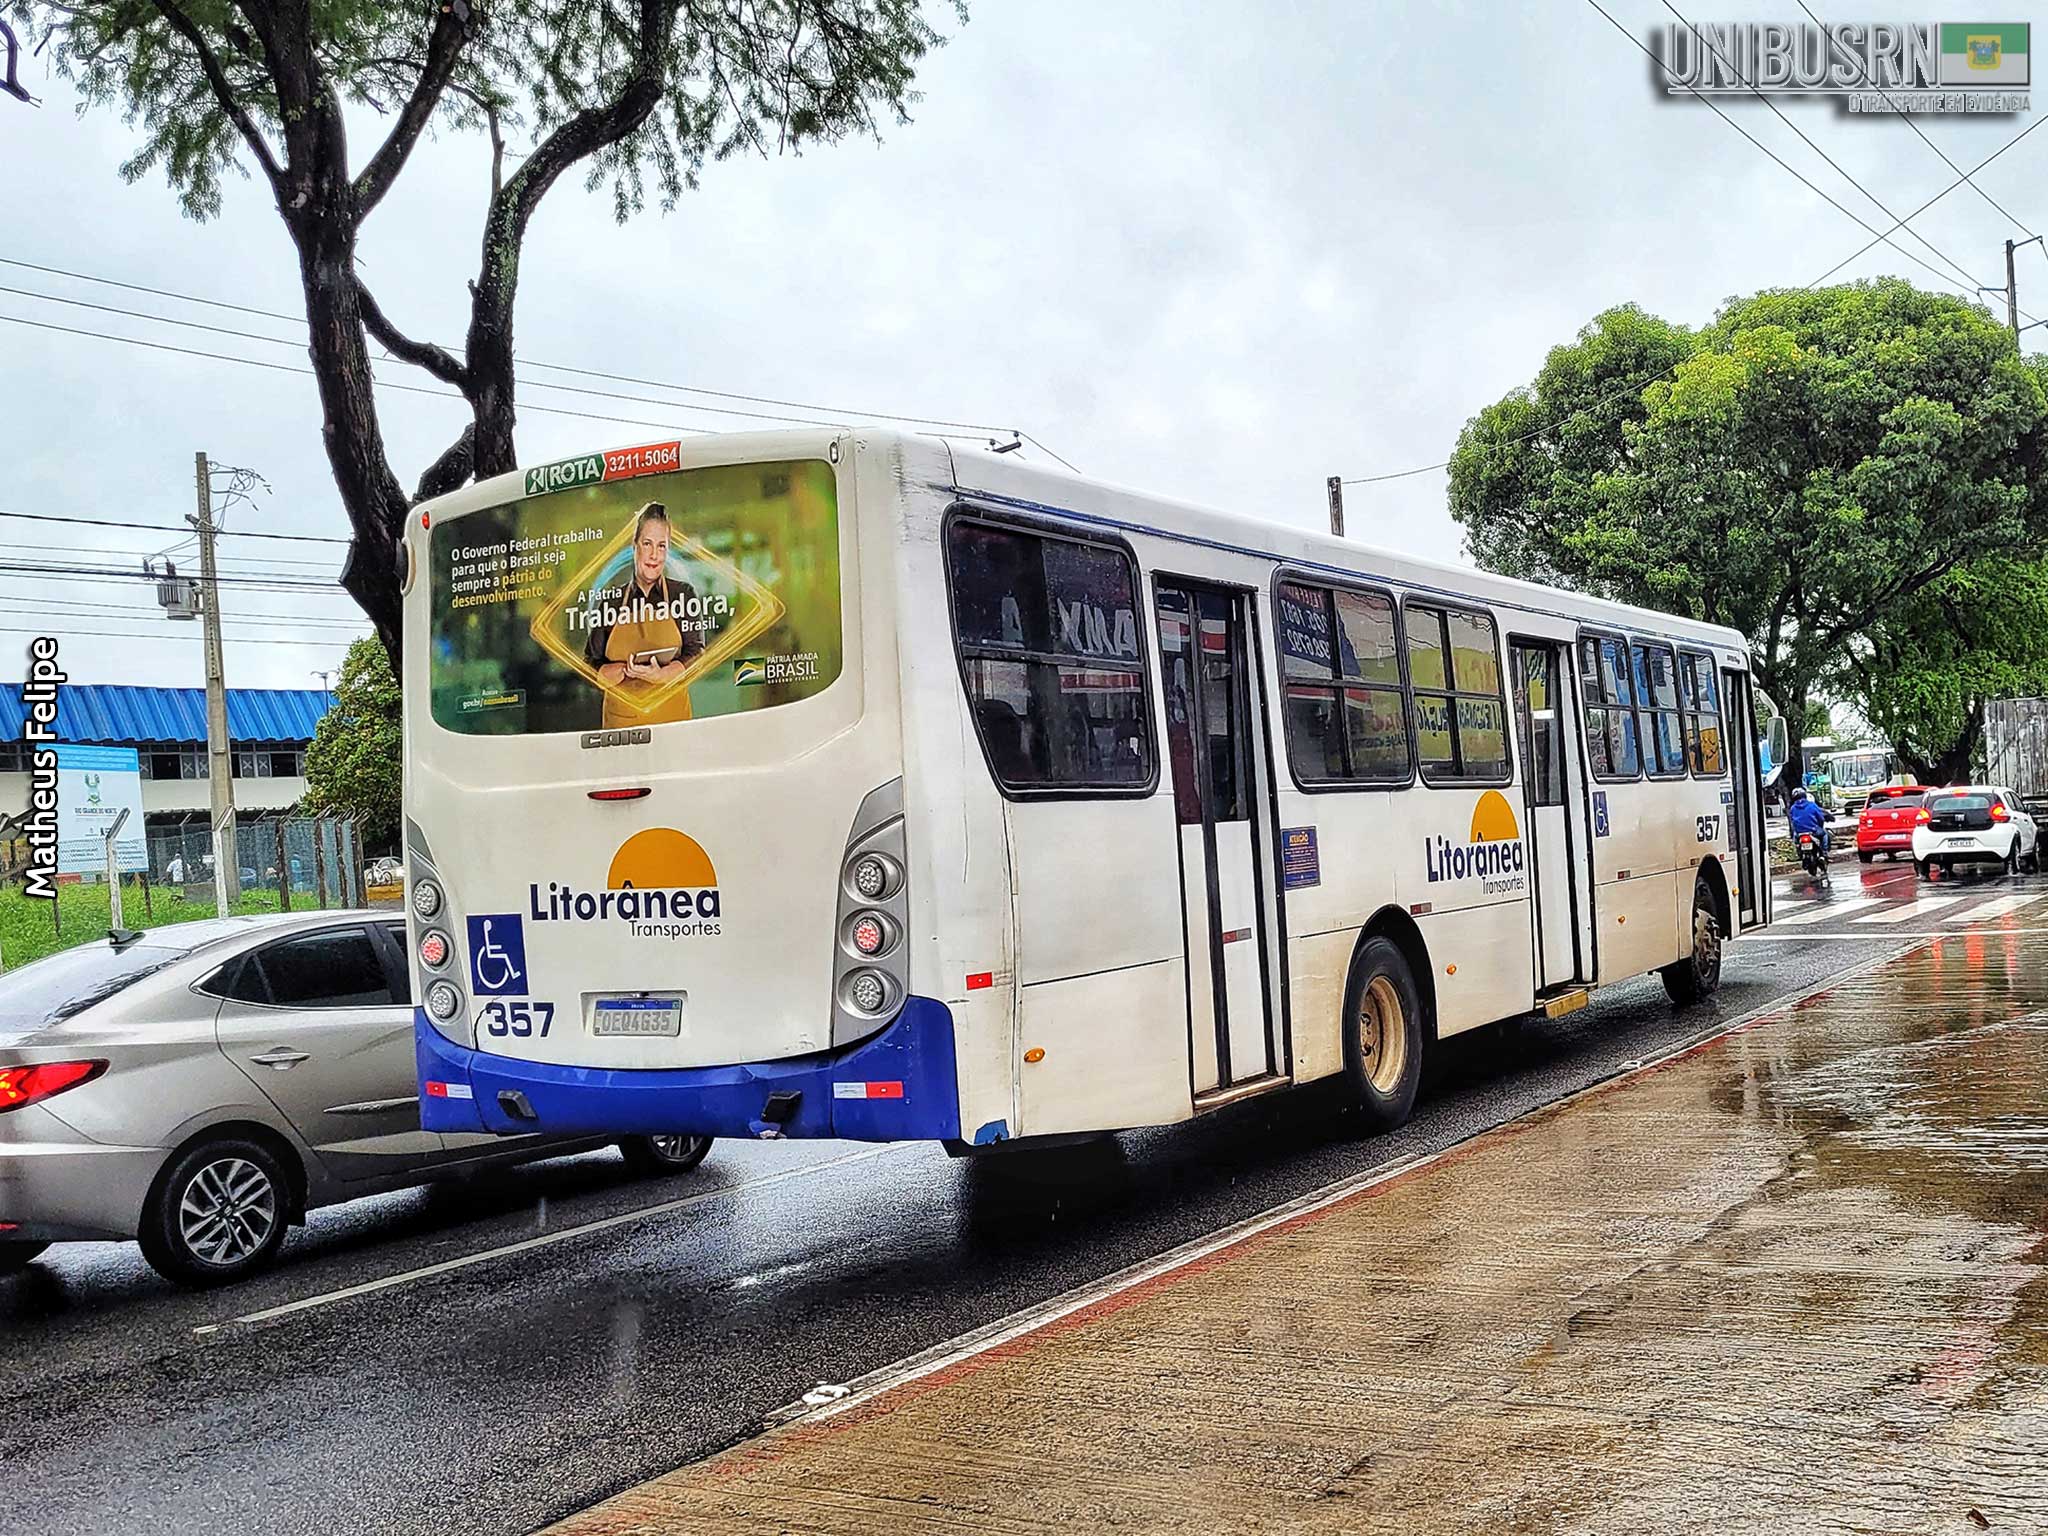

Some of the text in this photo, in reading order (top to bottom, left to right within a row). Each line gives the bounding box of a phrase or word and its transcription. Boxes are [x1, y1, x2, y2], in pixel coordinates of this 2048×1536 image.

[551, 458, 600, 487] ROTA
[609, 447, 677, 472] 3211.5064
[451, 528, 603, 561] O Governo Federal trabalha
[451, 550, 566, 580] para que o Brasil seja
[451, 567, 553, 593] sempre a pátria do
[451, 586, 546, 609] desenvolvimento.
[577, 587, 622, 603] A Pátria
[565, 592, 736, 631] Trabalhadora,
[681, 617, 720, 632] Brasil.
[792, 652, 818, 661] AMADA
[767, 661, 819, 679] BRASIL
[1696, 815, 1720, 842] 357
[1425, 832, 1523, 882] Litorânea
[1482, 875, 1524, 897] Transportes
[530, 880, 721, 921] Litorânea
[629, 920, 721, 940] Transportes
[486, 1001, 555, 1037] 357
